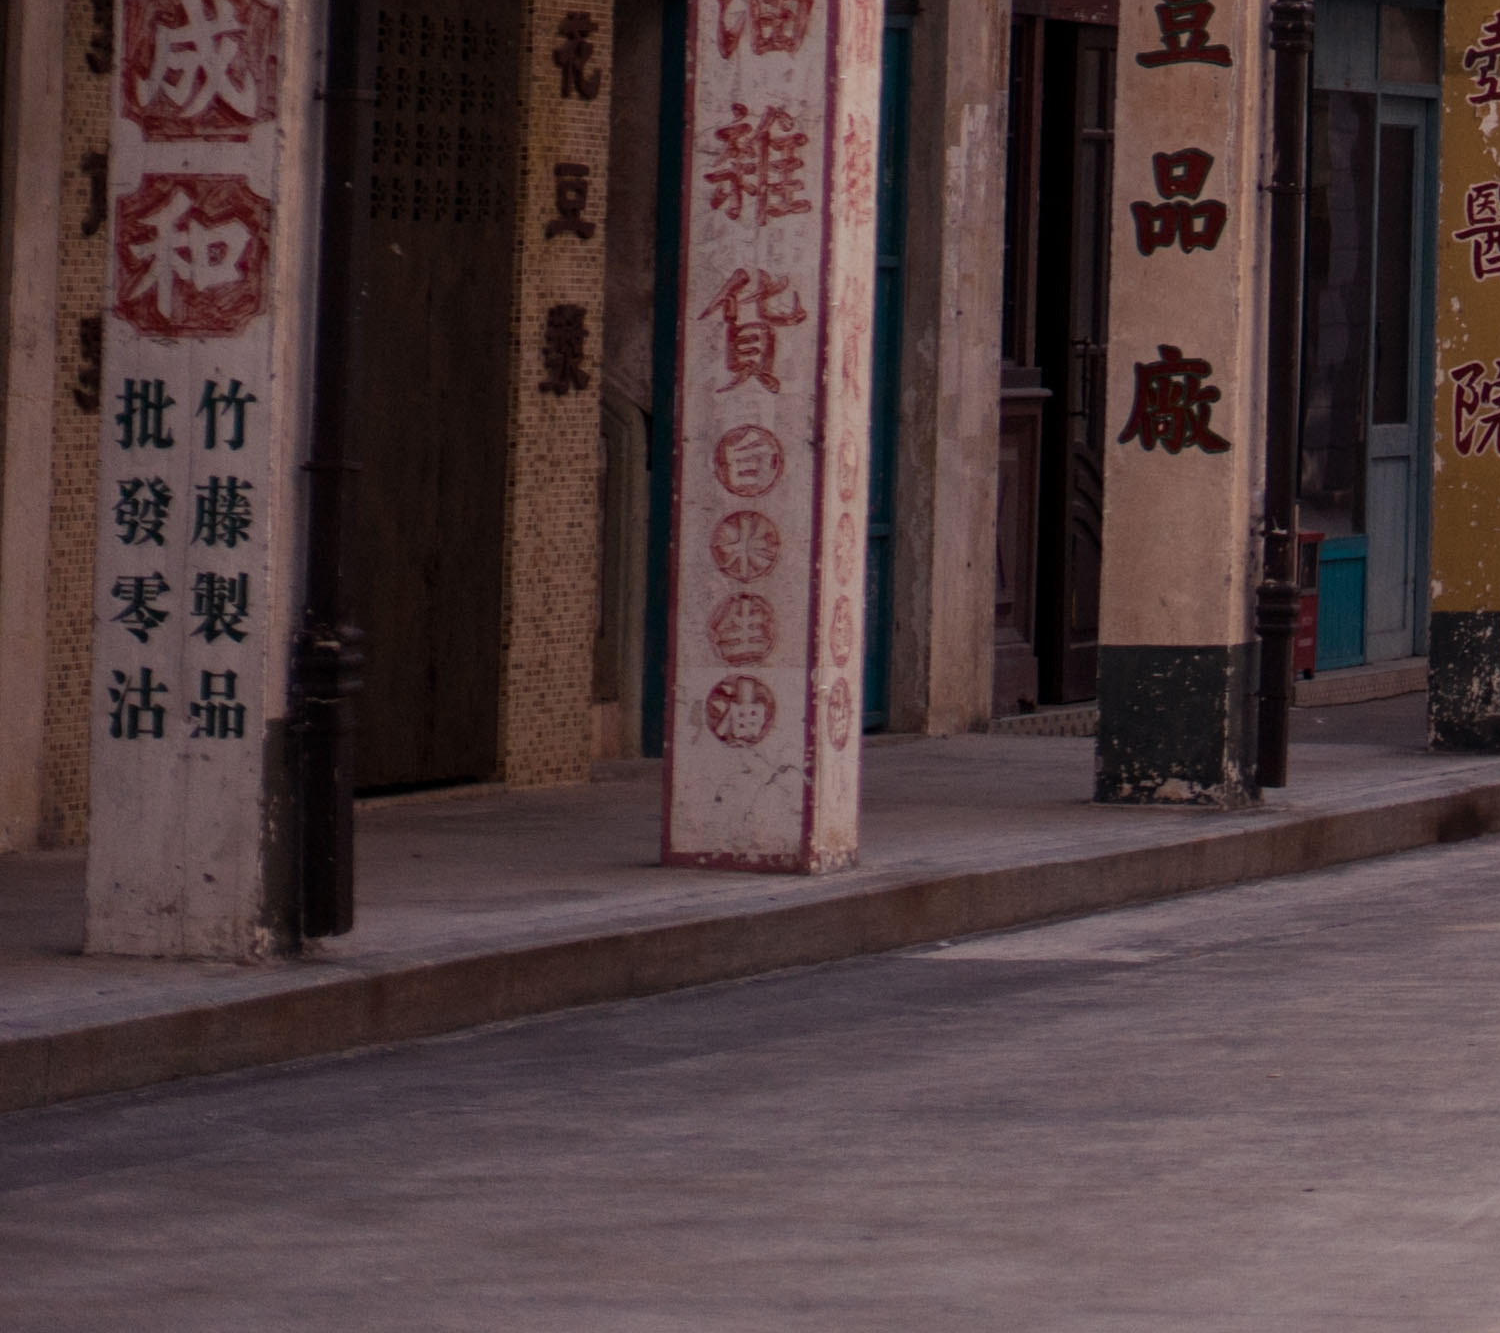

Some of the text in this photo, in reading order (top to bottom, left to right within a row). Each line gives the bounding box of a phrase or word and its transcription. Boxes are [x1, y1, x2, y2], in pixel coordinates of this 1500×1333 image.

[106, 377, 178, 743] 批發零沽
[188, 377, 258, 742] 竹藤製品
